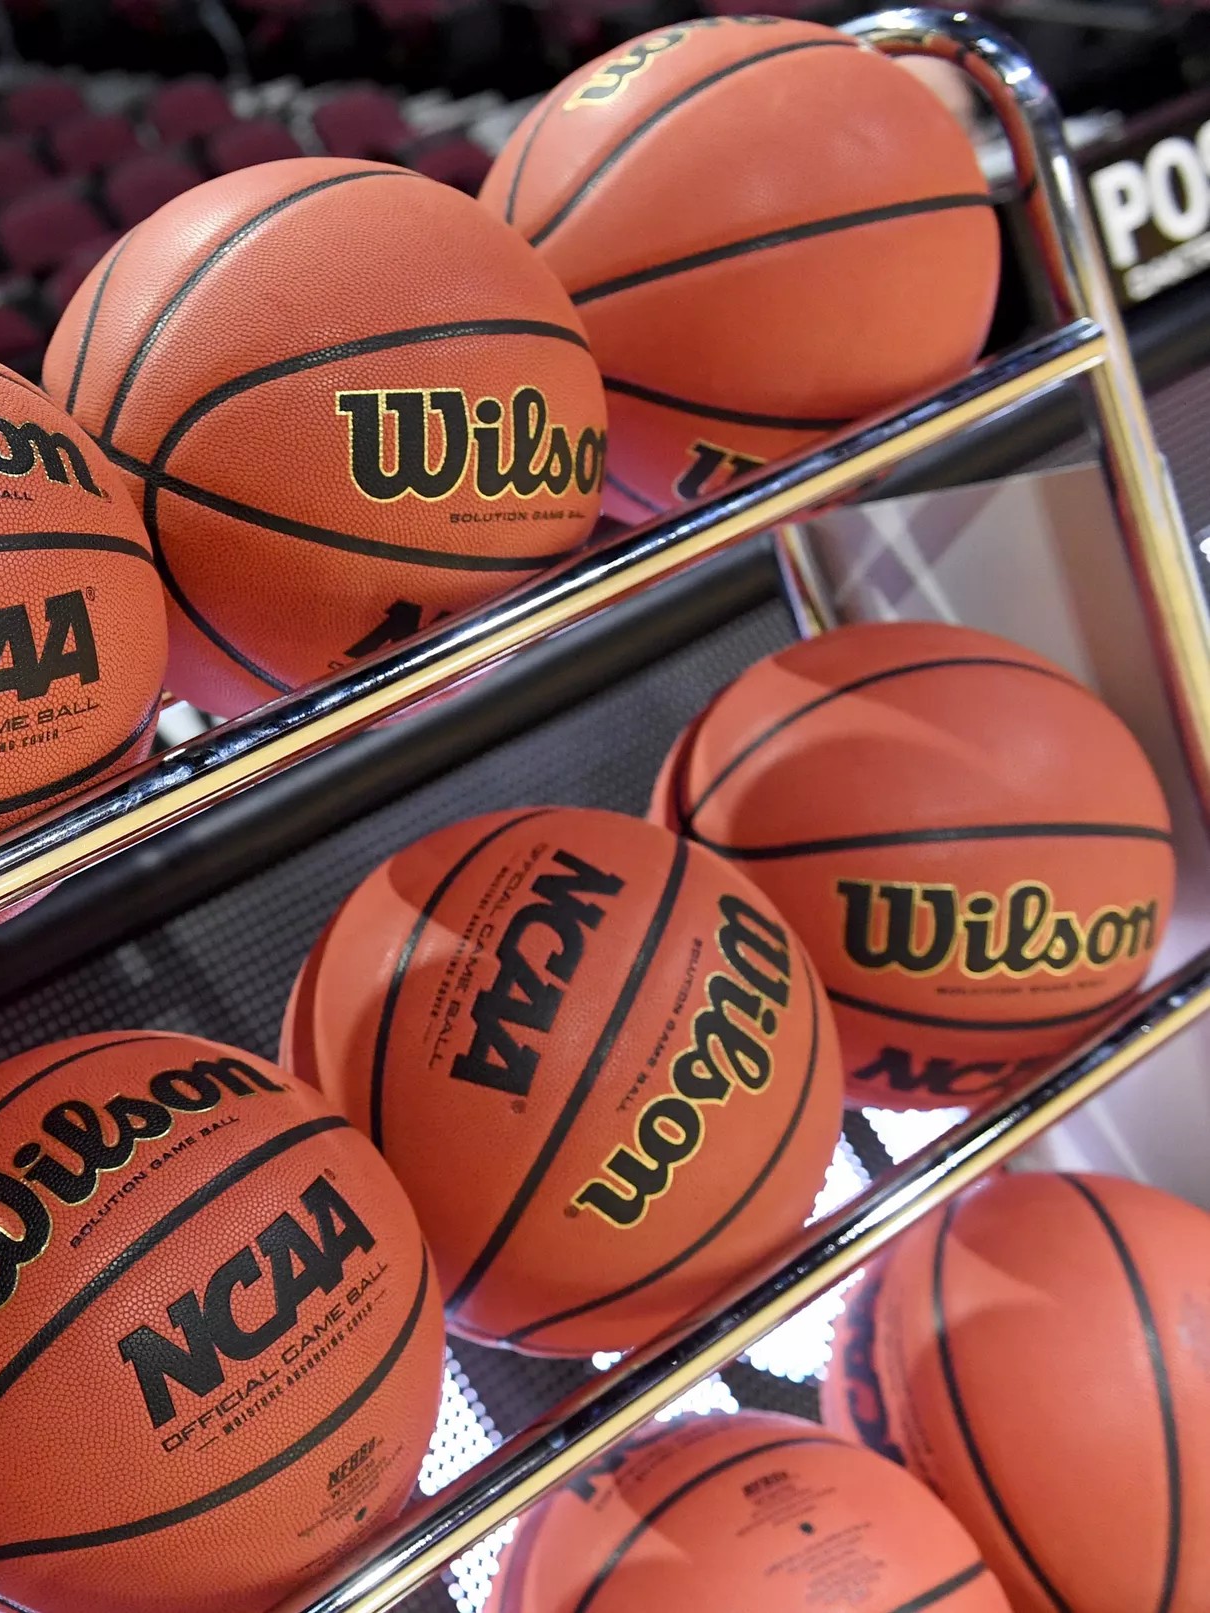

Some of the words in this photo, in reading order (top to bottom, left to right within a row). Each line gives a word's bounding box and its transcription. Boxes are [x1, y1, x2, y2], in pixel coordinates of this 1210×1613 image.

[1088, 118, 1210, 268] PO
[450, 511, 528, 524] SOLUTION
[21, 728, 60, 748] COVER
[37, 698, 101, 725] BALL
[450, 849, 626, 1097] NCAA
[454, 923, 495, 993] GAME
[835, 879, 1160, 977] Wilson
[427, 1000, 461, 1071] BALL
[571, 893, 791, 1229] Wilson
[70, 1171, 147, 1249] SOLUTION
[150, 1135, 197, 1170] GAME
[198, 1115, 240, 1137] BALL
[118, 1173, 377, 1430] NCAA
[161, 1369, 280, 1453] OFFICIAL
[281, 1302, 346, 1366] GAME
[345, 1262, 389, 1307] BALL
[222, 1384, 284, 1436] MOISTURE
